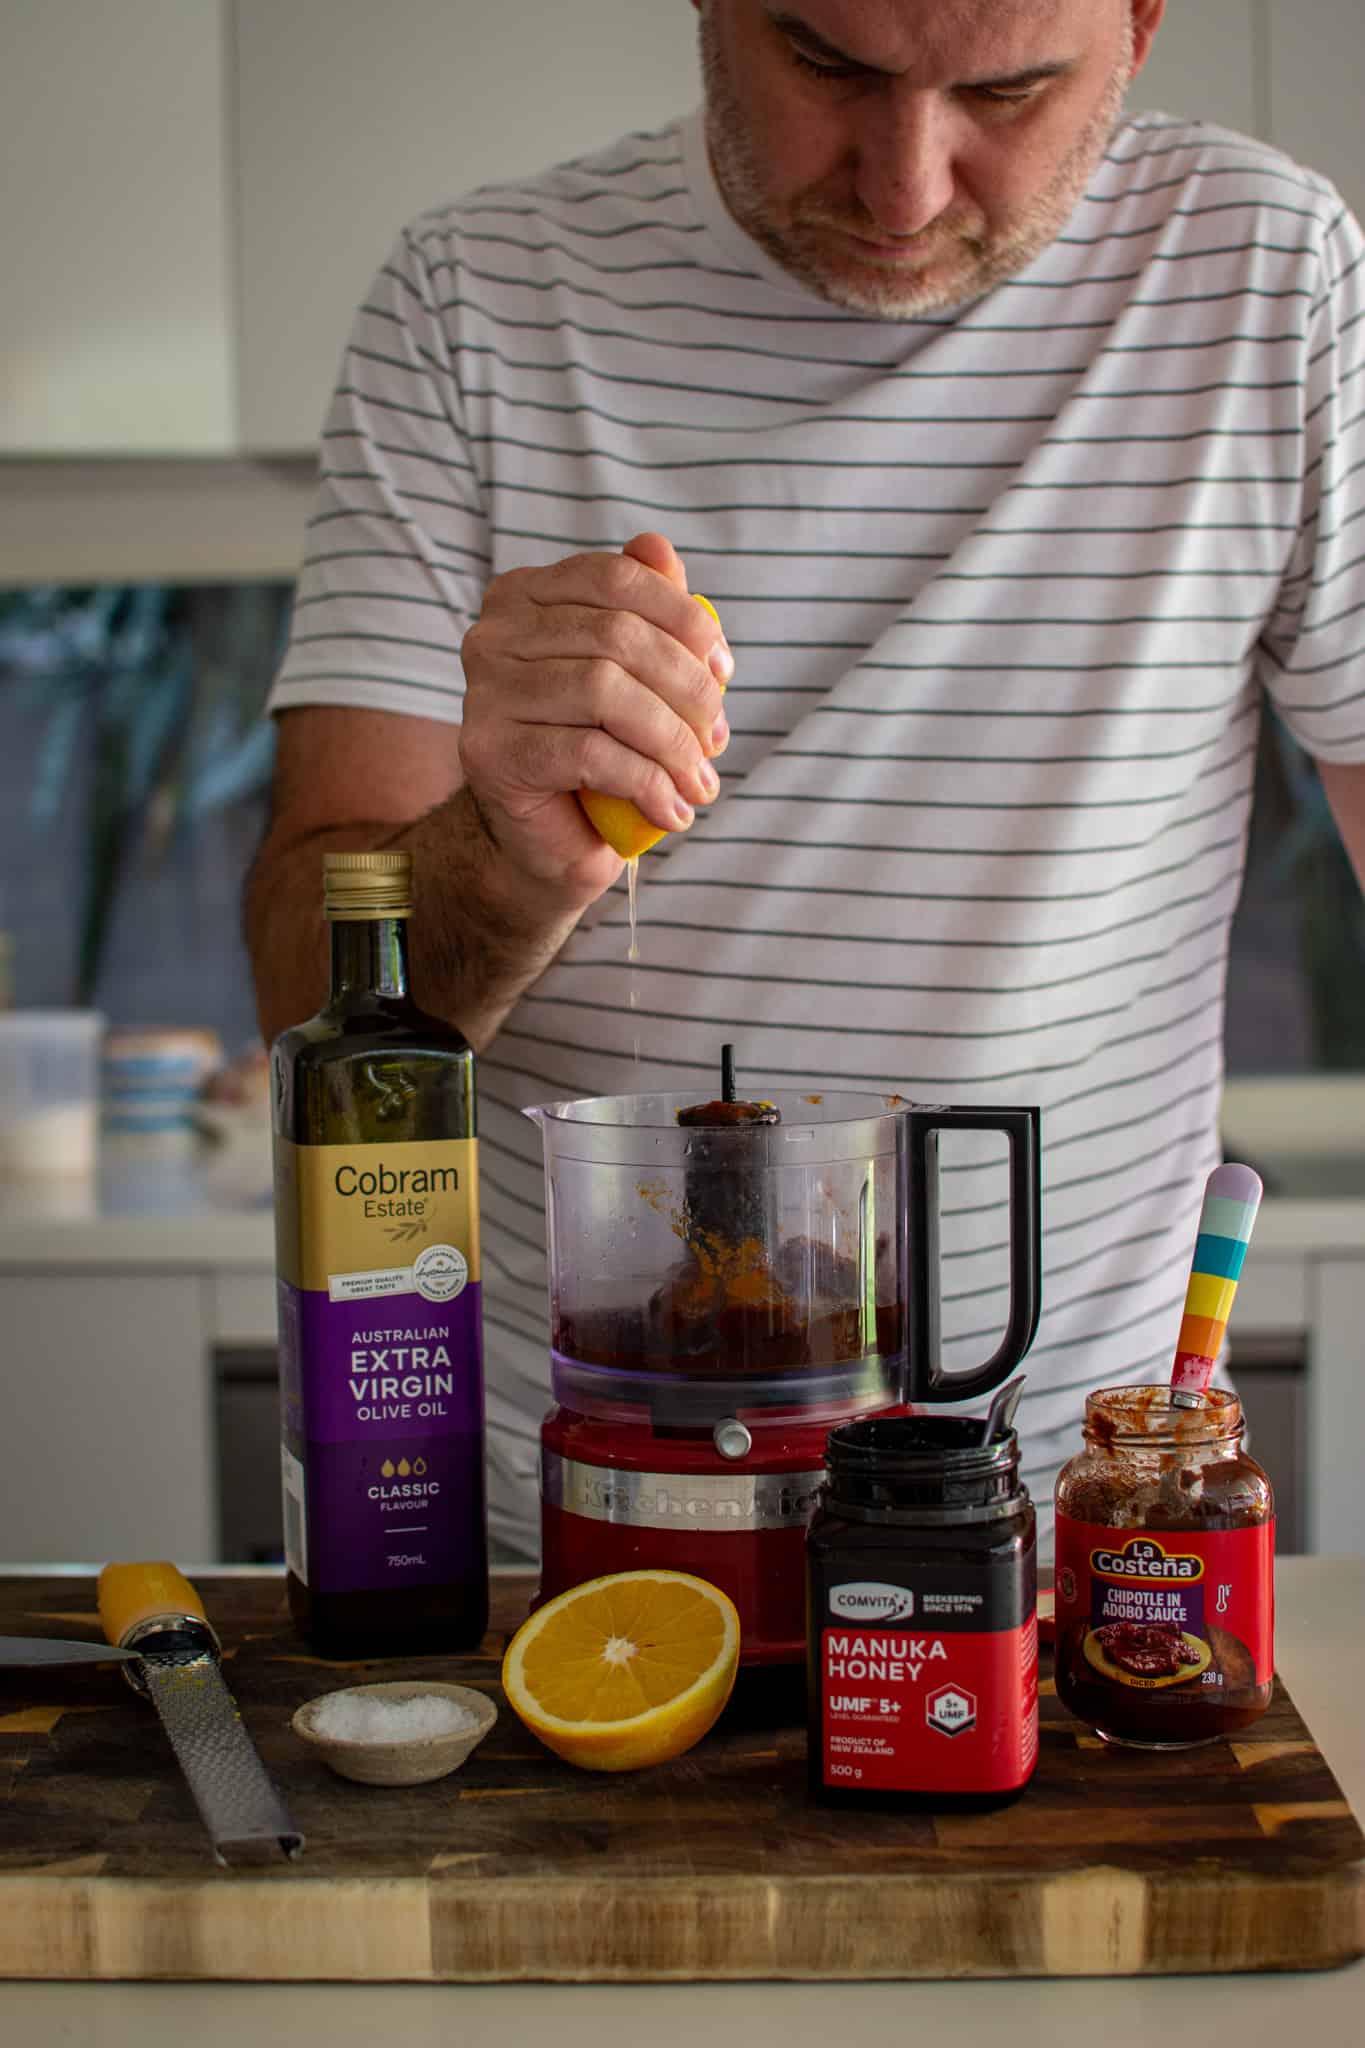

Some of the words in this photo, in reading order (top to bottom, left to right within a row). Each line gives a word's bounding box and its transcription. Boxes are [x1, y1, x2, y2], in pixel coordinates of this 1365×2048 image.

[335, 1163, 458, 1196] Cobram
[364, 1199, 425, 1218] Estate
[342, 1278, 373, 1287] PREMIUM
[374, 1275, 403, 1284] QUALITY
[375, 1283, 396, 1291] TASTE
[352, 1327, 449, 1344] AUSTRALIAN
[351, 1345, 452, 1373] EXTRA
[349, 1374, 453, 1401] VIRGIN
[357, 1403, 411, 1421] OLIVE
[417, 1402, 448, 1418] OIL
[367, 1482, 440, 1499] CLASSIC
[380, 1499, 428, 1512] FLAVOUR
[1133, 1543, 1153, 1558] La
[386, 1553, 426, 1567] 750mL
[1097, 1553, 1193, 1577] Costeña
[838, 1594, 896, 1608] COMVITA
[923, 1594, 984, 1605] BEEKEEPING
[1107, 1588, 1164, 1607] CHIPOTLE
[1167, 1593, 1181, 1608] IN
[923, 1603, 953, 1613] SINCE
[1102, 1602, 1143, 1620] ADOBO
[1146, 1606, 1187, 1622] SAUCE
[828, 1636, 948, 1660] MANUKA
[828, 1660, 923, 1681] HONEY
[1201, 1671, 1216, 1684] 230
[1217, 1673, 1223, 1686] g
[879, 1698, 902, 1714] 5+
[944, 1698, 959, 1708] 5+
[938, 1710, 965, 1720] UMF
[830, 1736, 871, 1745] PRODUCT
[873, 1738, 886, 1746] OF
[830, 1744, 852, 1753] NEW
[853, 1745, 895, 1755] ZEALAND
[830, 1764, 853, 1776] 500
[854, 1767, 862, 1779] g
